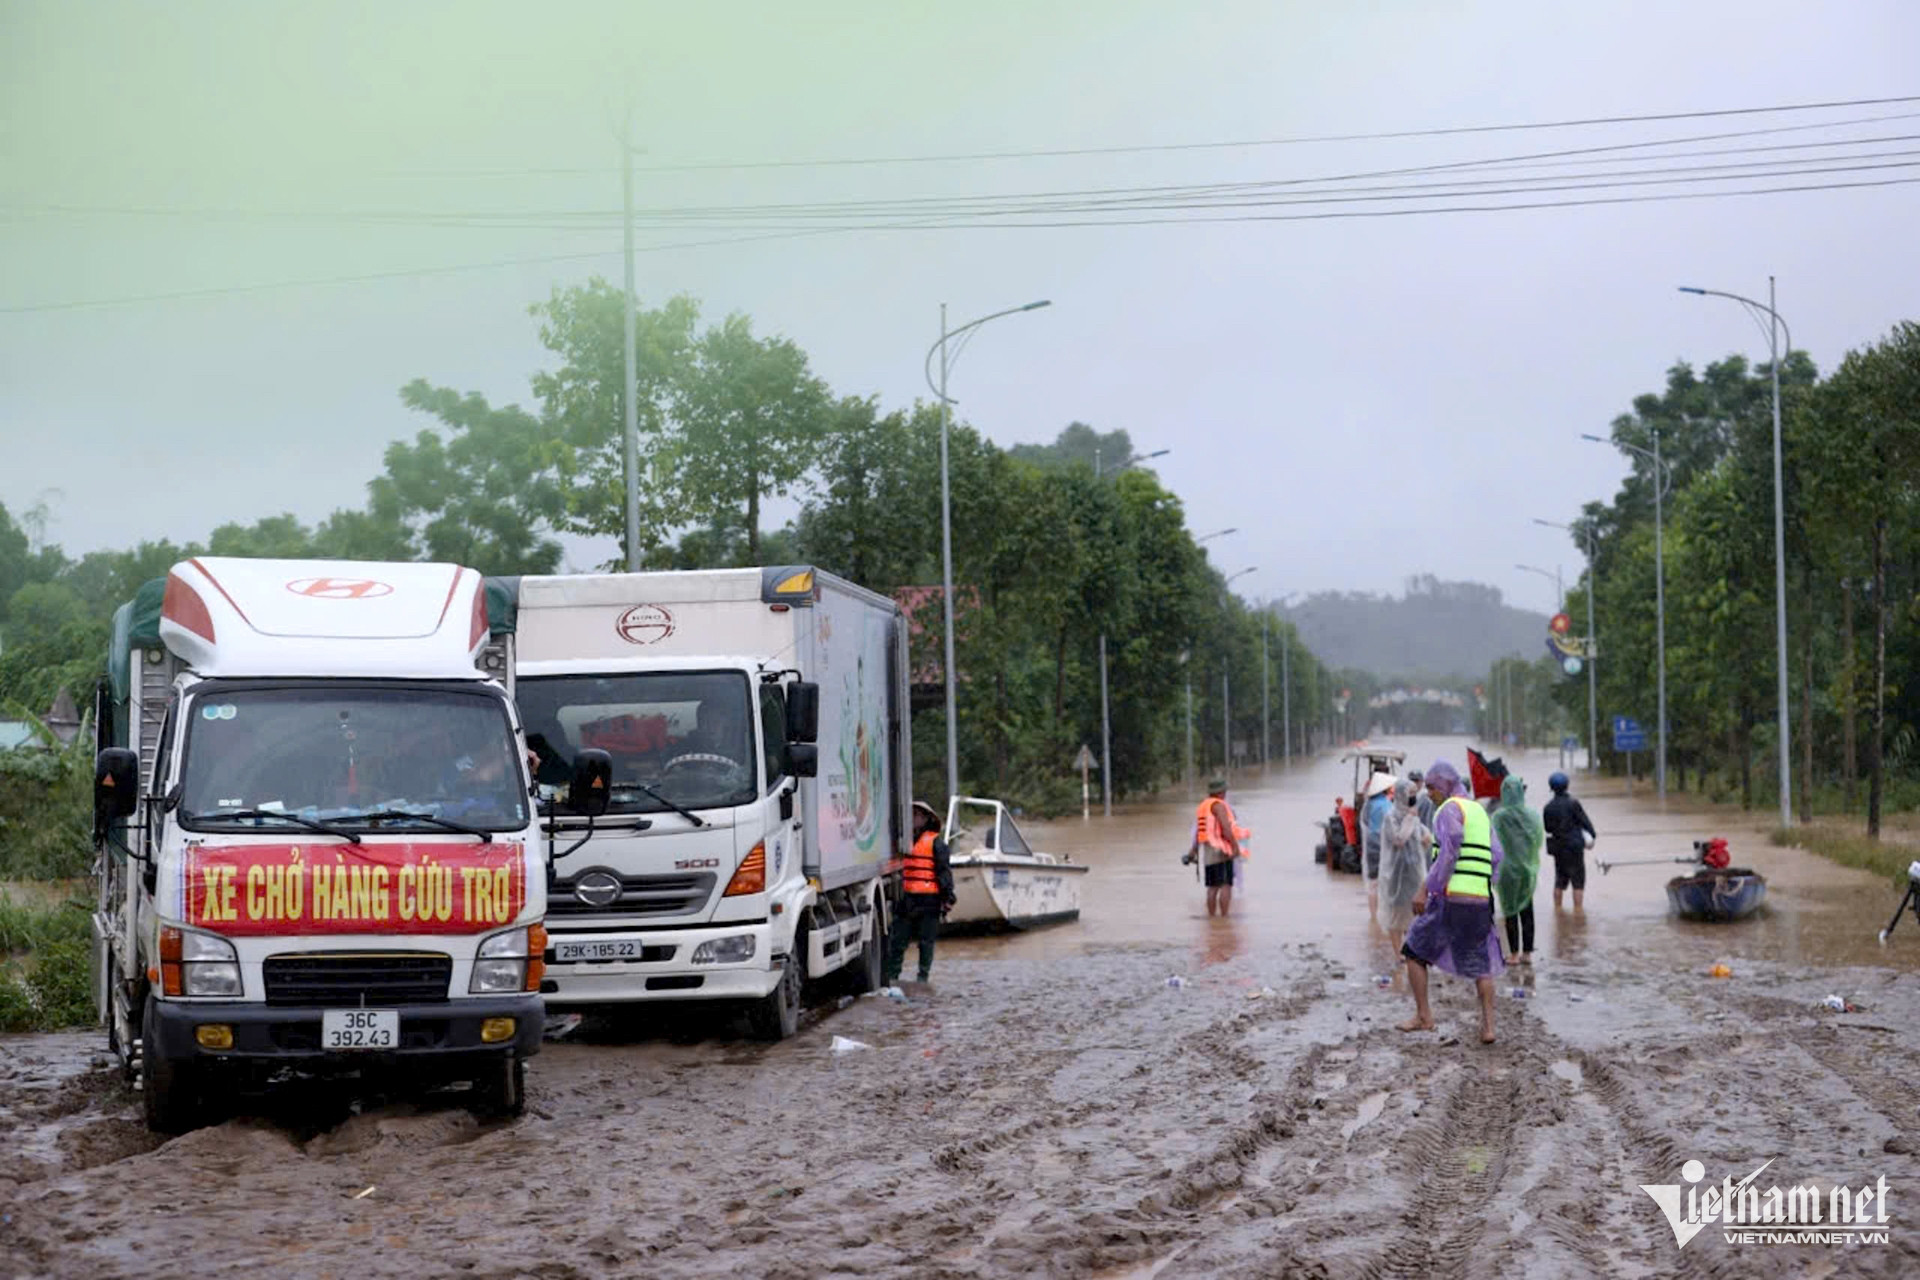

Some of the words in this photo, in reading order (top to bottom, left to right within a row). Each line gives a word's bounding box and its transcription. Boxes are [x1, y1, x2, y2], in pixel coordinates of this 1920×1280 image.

[674, 858, 719, 869] 500
[202, 865, 238, 921] XE
[247, 847, 304, 920] CHỞ
[313, 853, 389, 920] HÀNG
[399, 854, 453, 921] CỨU
[563, 943, 634, 958] 29K-185.22
[345, 1012, 377, 1028] 36C
[331, 1030, 391, 1046] 392.43
